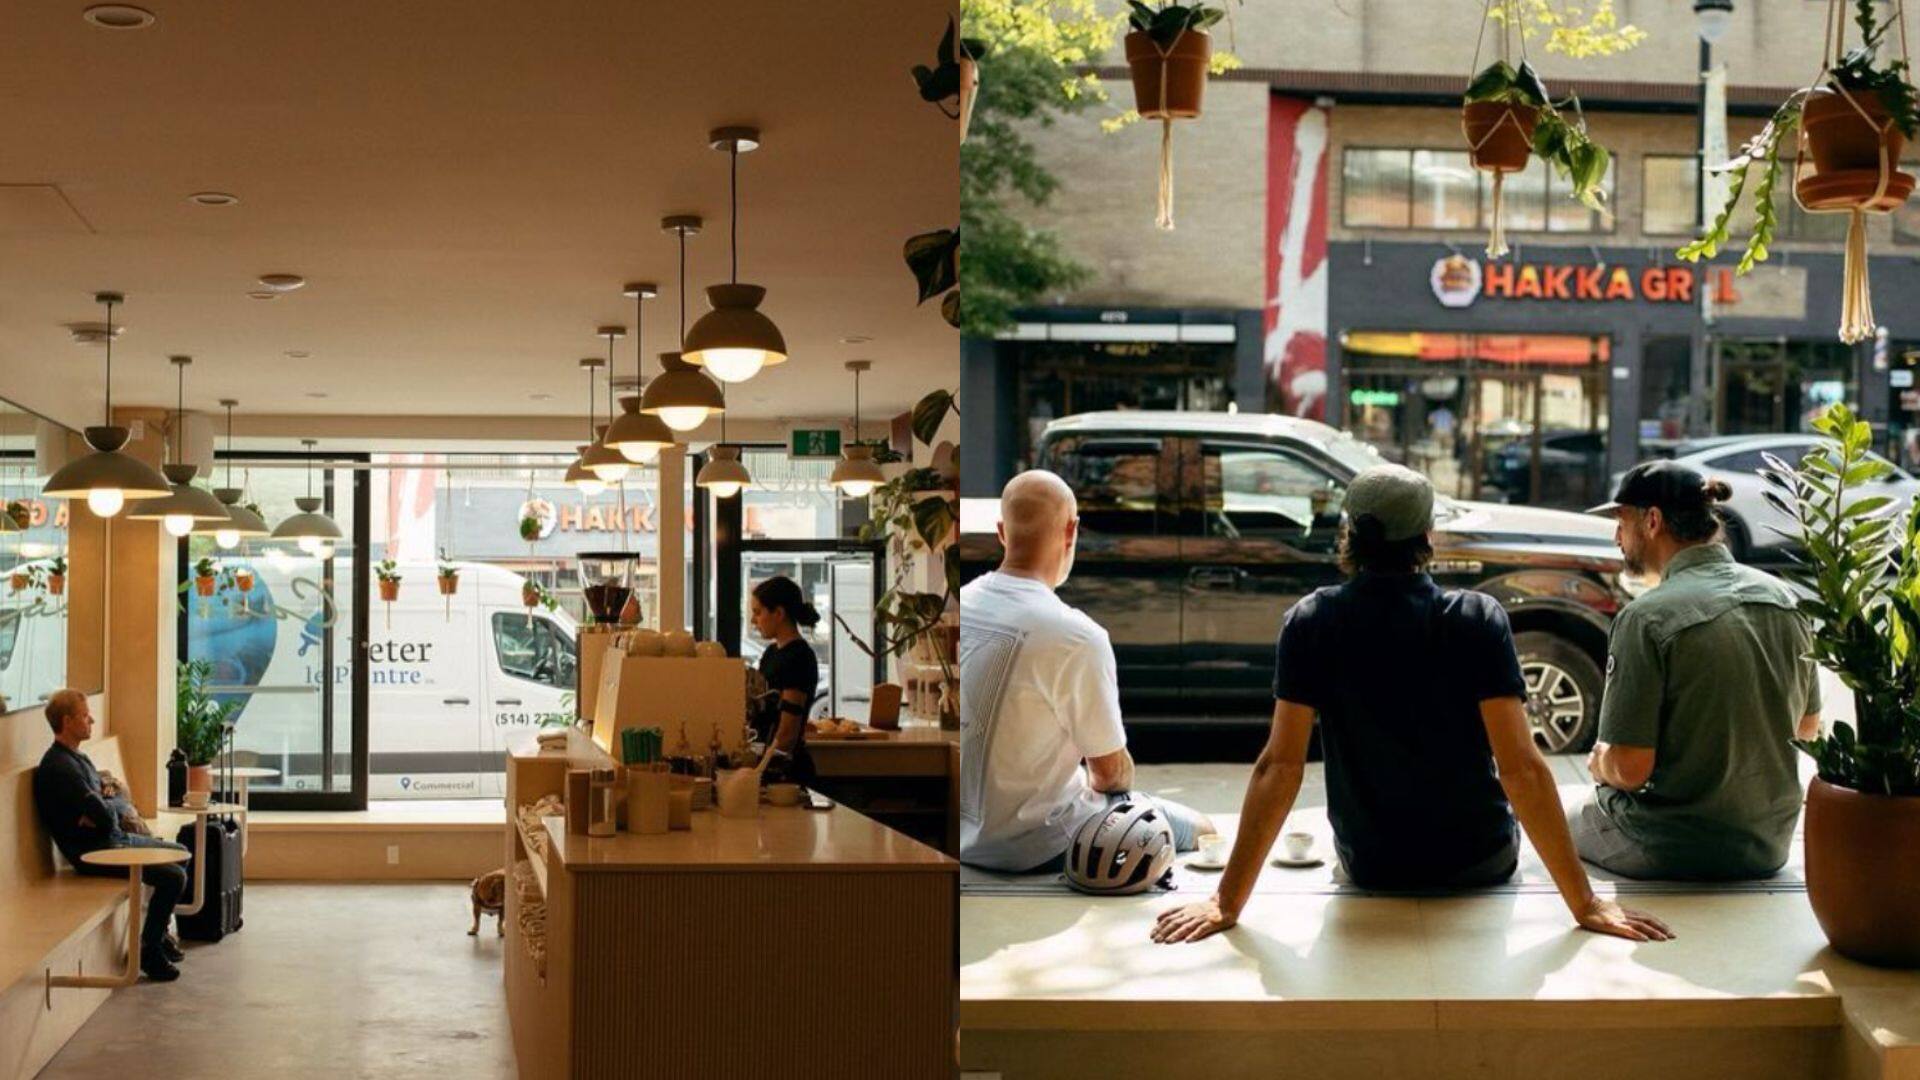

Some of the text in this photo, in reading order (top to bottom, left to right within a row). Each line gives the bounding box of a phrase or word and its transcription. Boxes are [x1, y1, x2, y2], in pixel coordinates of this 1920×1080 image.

[1483, 262, 1743, 305] HAKKA GRL
[559, 503, 658, 533] HAKK
[346, 636, 433, 663] eter
[335, 665, 422, 684] Pntre
[494, 712, 530, 727] (514)
[412, 781, 475, 791] Commercial
